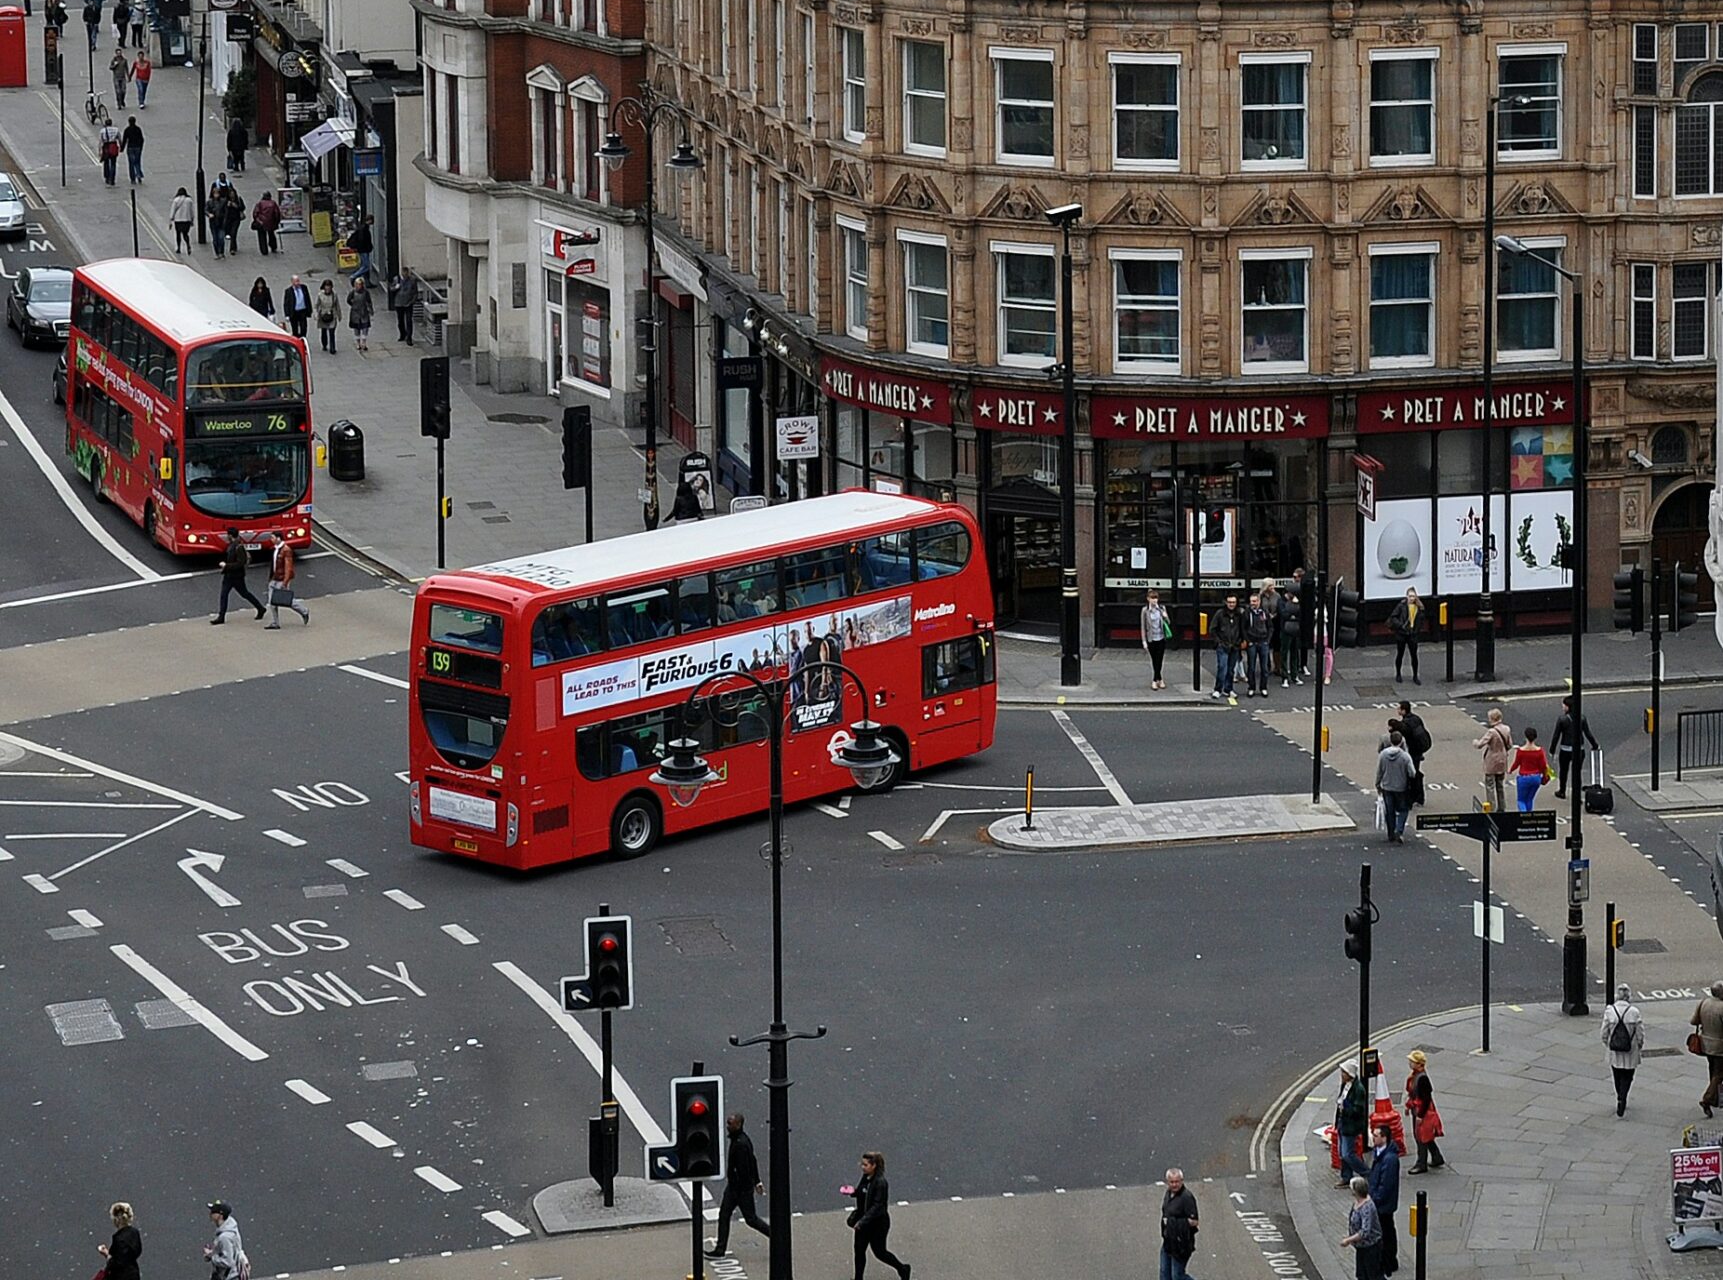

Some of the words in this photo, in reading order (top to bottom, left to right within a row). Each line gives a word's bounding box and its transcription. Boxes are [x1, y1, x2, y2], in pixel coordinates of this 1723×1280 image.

[723, 364, 756, 376] RUSH
[832, 370, 852, 398] PRET
[858, 380, 864, 401] A
[870, 380, 916, 412] MANGER
[998, 398, 1036, 426] PRET
[1136, 406, 1178, 433] PRET
[1188, 408, 1199, 433] A
[1210, 407, 1285, 433] MANGER
[1404, 397, 1444, 424] PRET
[1454, 399, 1464, 422] A
[1474, 393, 1546, 420] MANGER
[205, 420, 252, 431] Waterloo
[267, 414, 287, 431] 76
[779, 420, 816, 436] CROWN
[779, 446, 798, 454] CAFE
[914, 603, 956, 622] Metroline
[432, 651, 450, 672] 139
[642, 654, 688, 679] FAST
[686, 656, 693, 666] &
[646, 660, 718, 692] FURIOUS
[720, 652, 733, 670] 6
[566, 684, 582, 694] ALL
[586, 676, 618, 689] ROADS
[574, 688, 599, 700] LEAD
[602, 686, 614, 694] TO
[617, 680, 636, 692] THIS
[271, 781, 370, 812] NO
[197, 919, 350, 964] BUS
[242, 961, 427, 1016] ONLY
[1637, 987, 1696, 1000] LOOK
[1674, 1154, 1704, 1168] 25%
[1705, 1156, 1718, 1165] off
[1235, 1210, 1285, 1242] RIGHT
